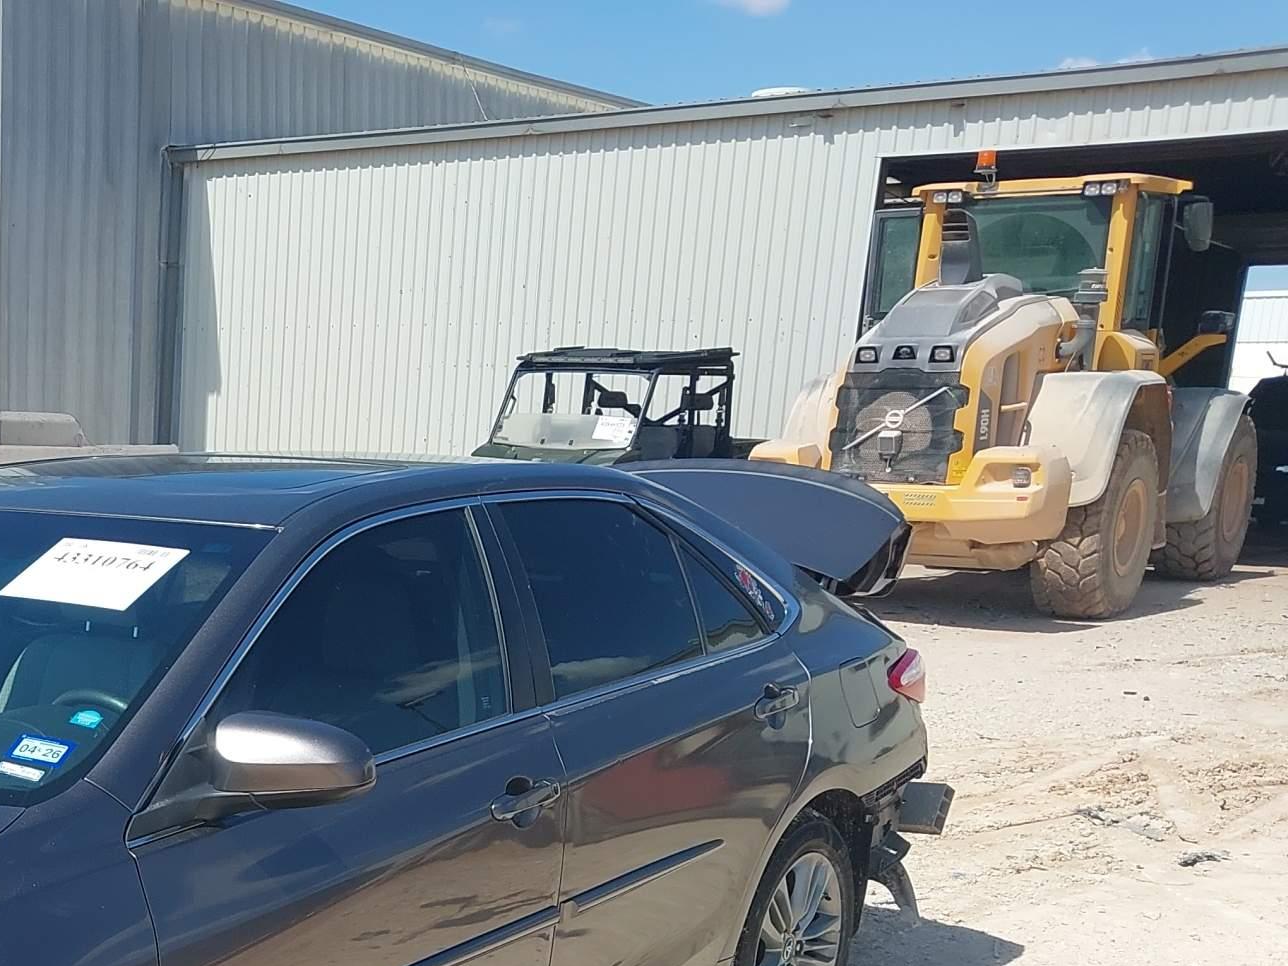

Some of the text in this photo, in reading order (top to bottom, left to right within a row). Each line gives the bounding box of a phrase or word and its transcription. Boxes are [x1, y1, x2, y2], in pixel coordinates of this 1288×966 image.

[979, 408, 990, 441] L90H
[53, 551, 156, 572] 43310764
[18, 743, 62, 760] 04 26
